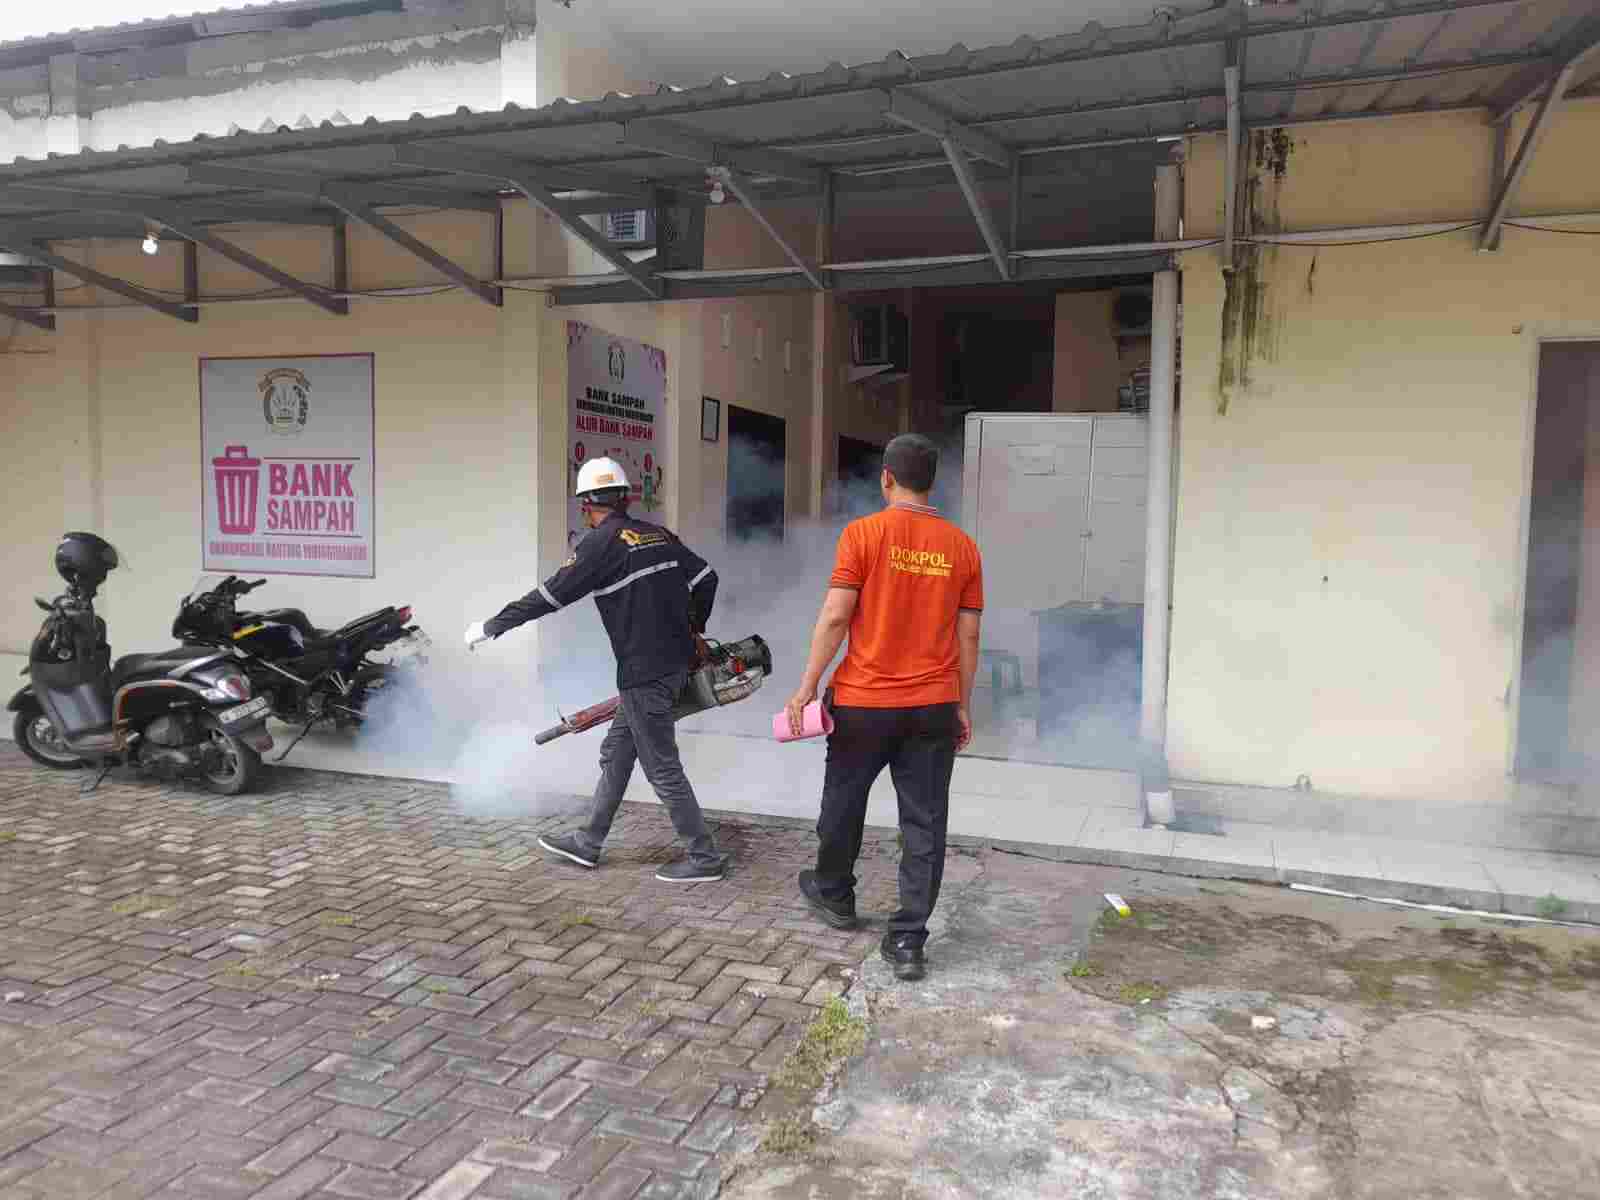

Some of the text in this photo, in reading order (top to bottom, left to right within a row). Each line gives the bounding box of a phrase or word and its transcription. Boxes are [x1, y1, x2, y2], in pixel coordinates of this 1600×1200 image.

[585, 386, 645, 409] BANK SAMPAH
[268, 463, 355, 497] BANK
[266, 499, 355, 532] SAMPAH
[889, 545, 953, 568] DOKPOL
